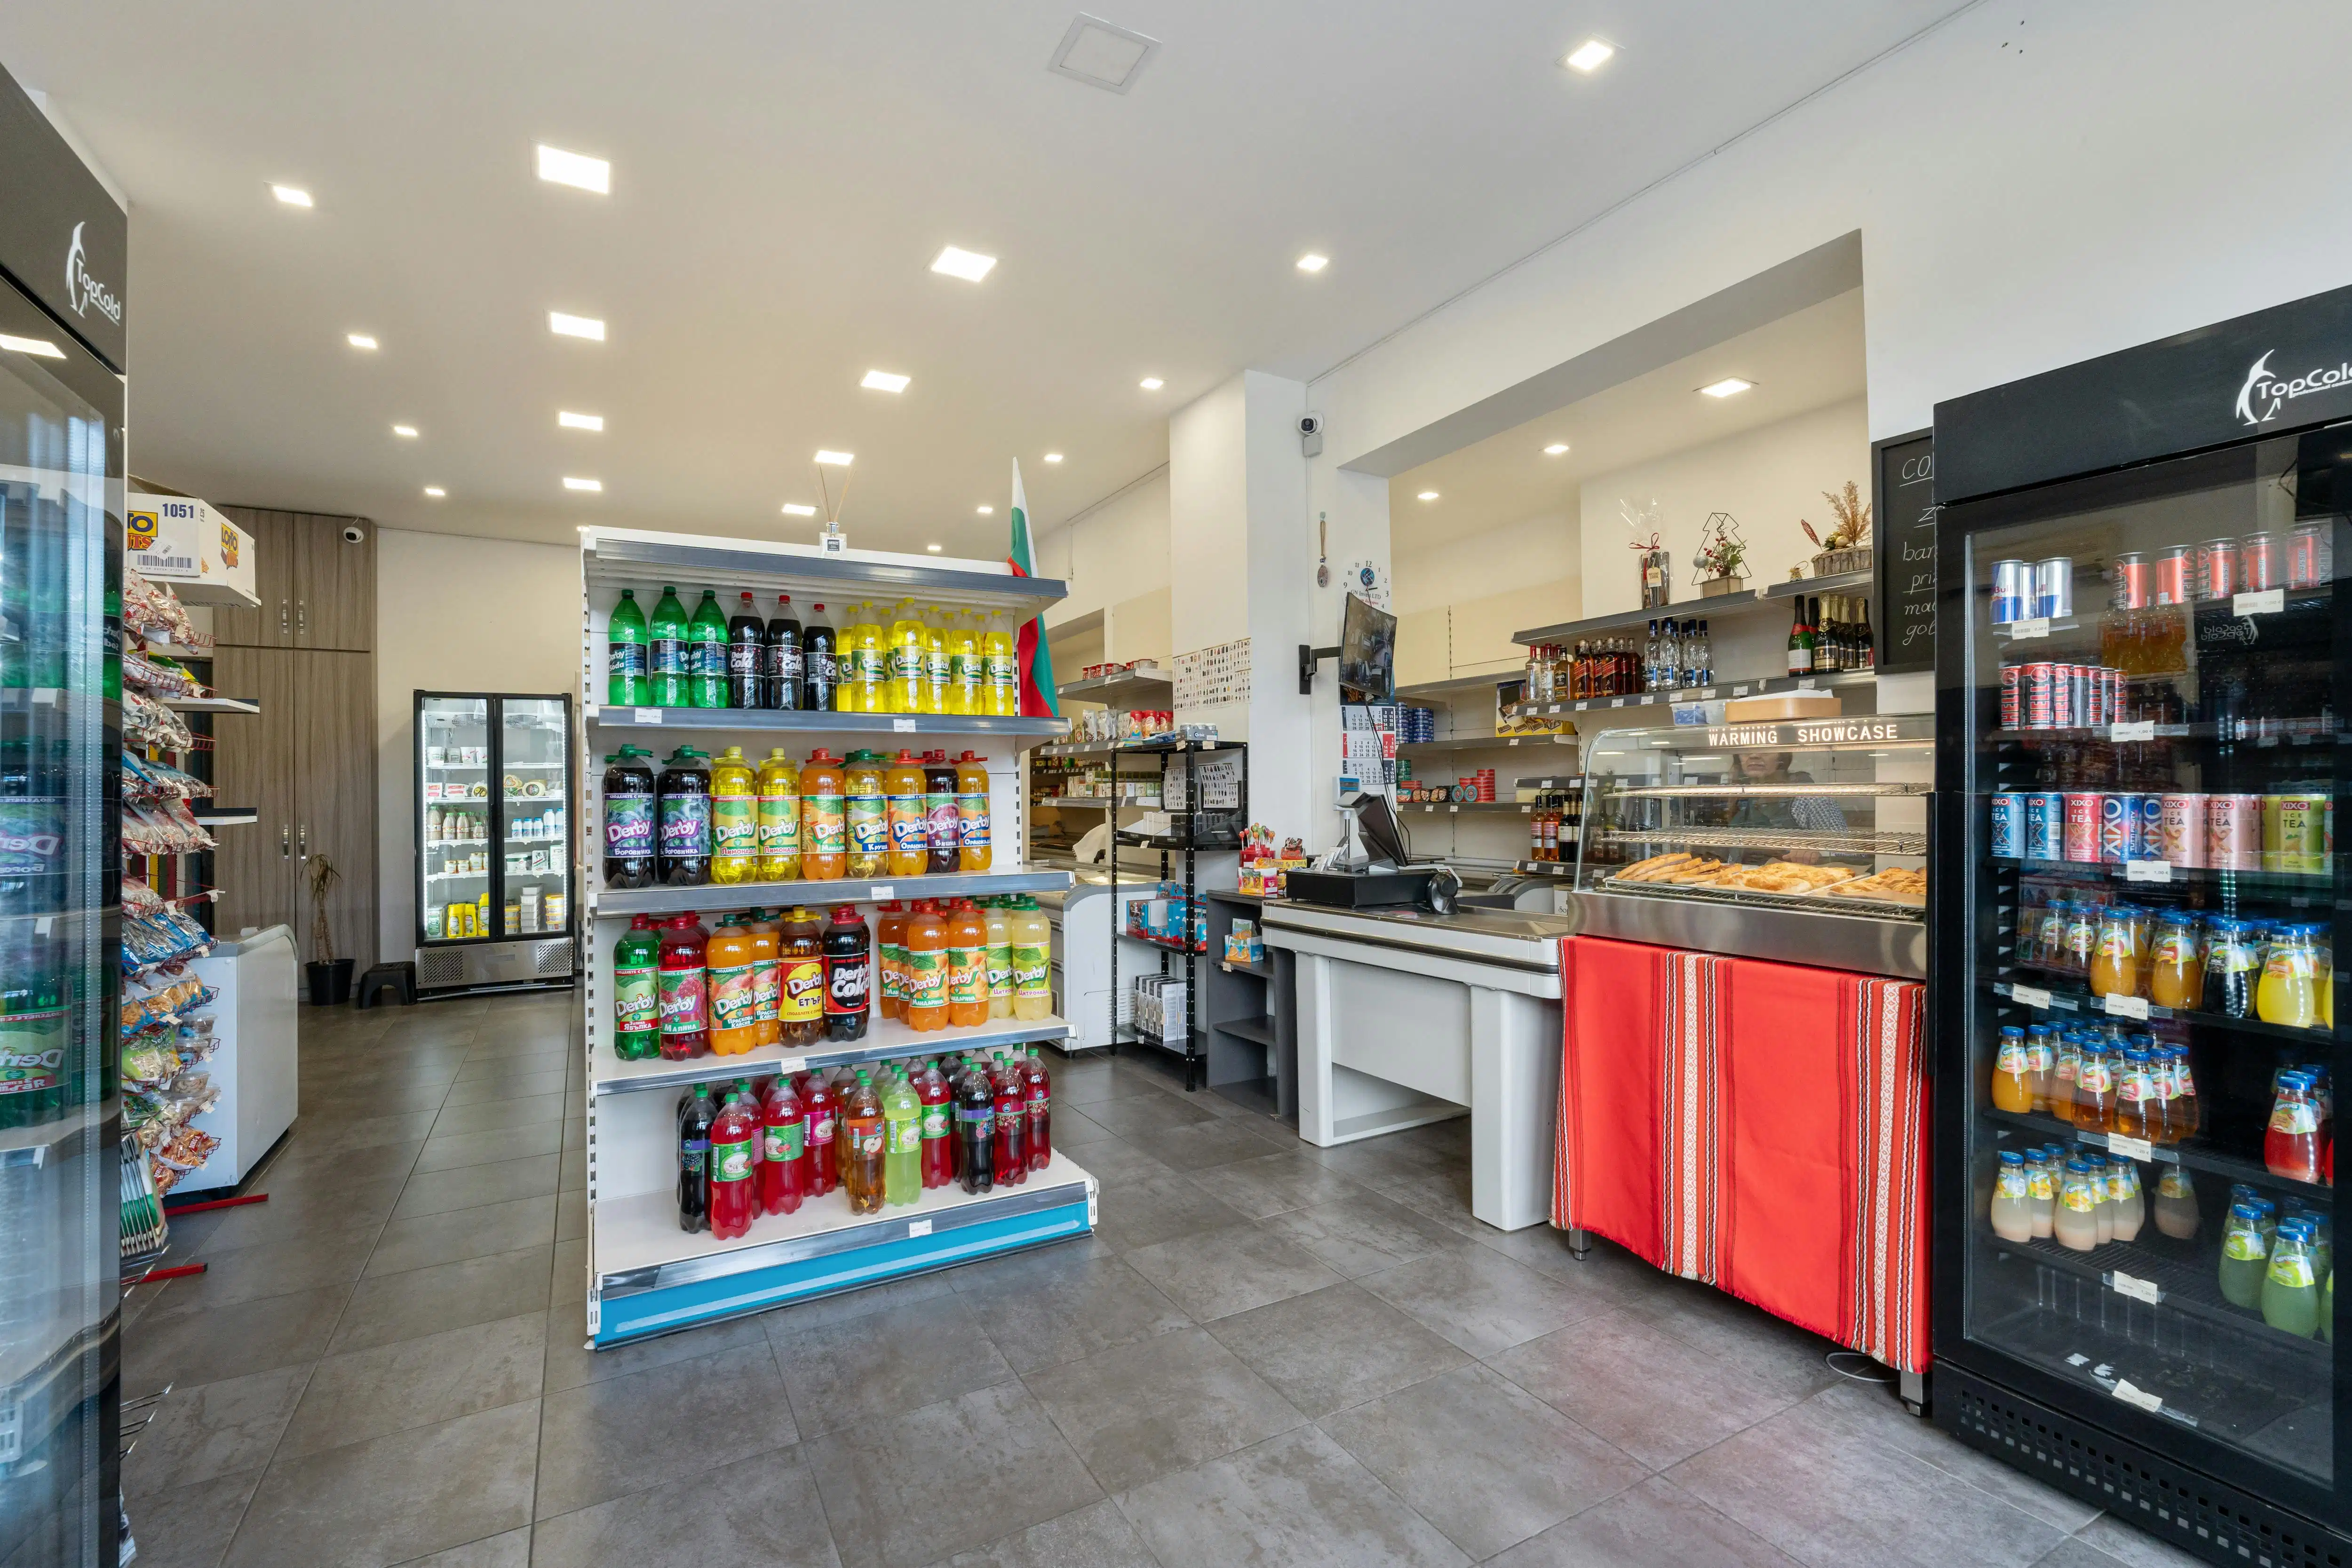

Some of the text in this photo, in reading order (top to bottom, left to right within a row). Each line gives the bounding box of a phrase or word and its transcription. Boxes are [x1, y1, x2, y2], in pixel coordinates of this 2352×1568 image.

[76, 257, 120, 320] TopCold
[162, 503, 194, 518] 1051
[731, 659, 753, 668] Cola
[896, 654, 920, 665] Derby
[927, 661, 949, 671] Derby
[991, 663, 1012, 672] Derby
[2001, 687, 2019, 723] HELL
[2030, 684, 2050, 722] HELL
[2055, 685, 2068, 722] HELL
[1708, 724, 1898, 746] WARMING SHOWCASE
[608, 819, 650, 842] Derby
[663, 820, 696, 841] Derby
[715, 820, 755, 842] Derby
[759, 820, 797, 841] Derby
[927, 816, 958, 835] Derby
[960, 814, 990, 834] Derby
[2103, 799, 2122, 856] XIXO
[2143, 799, 2162, 857] XIXO
[2282, 820, 2306, 828] TEA
[788, 971, 822, 995] Derby
[909, 971, 945, 994] Derby
[1014, 965, 1046, 984] Derby
[615, 994, 656, 1017] Derby
[660, 995, 697, 1016] Derby
[715, 990, 753, 1015] Derby
